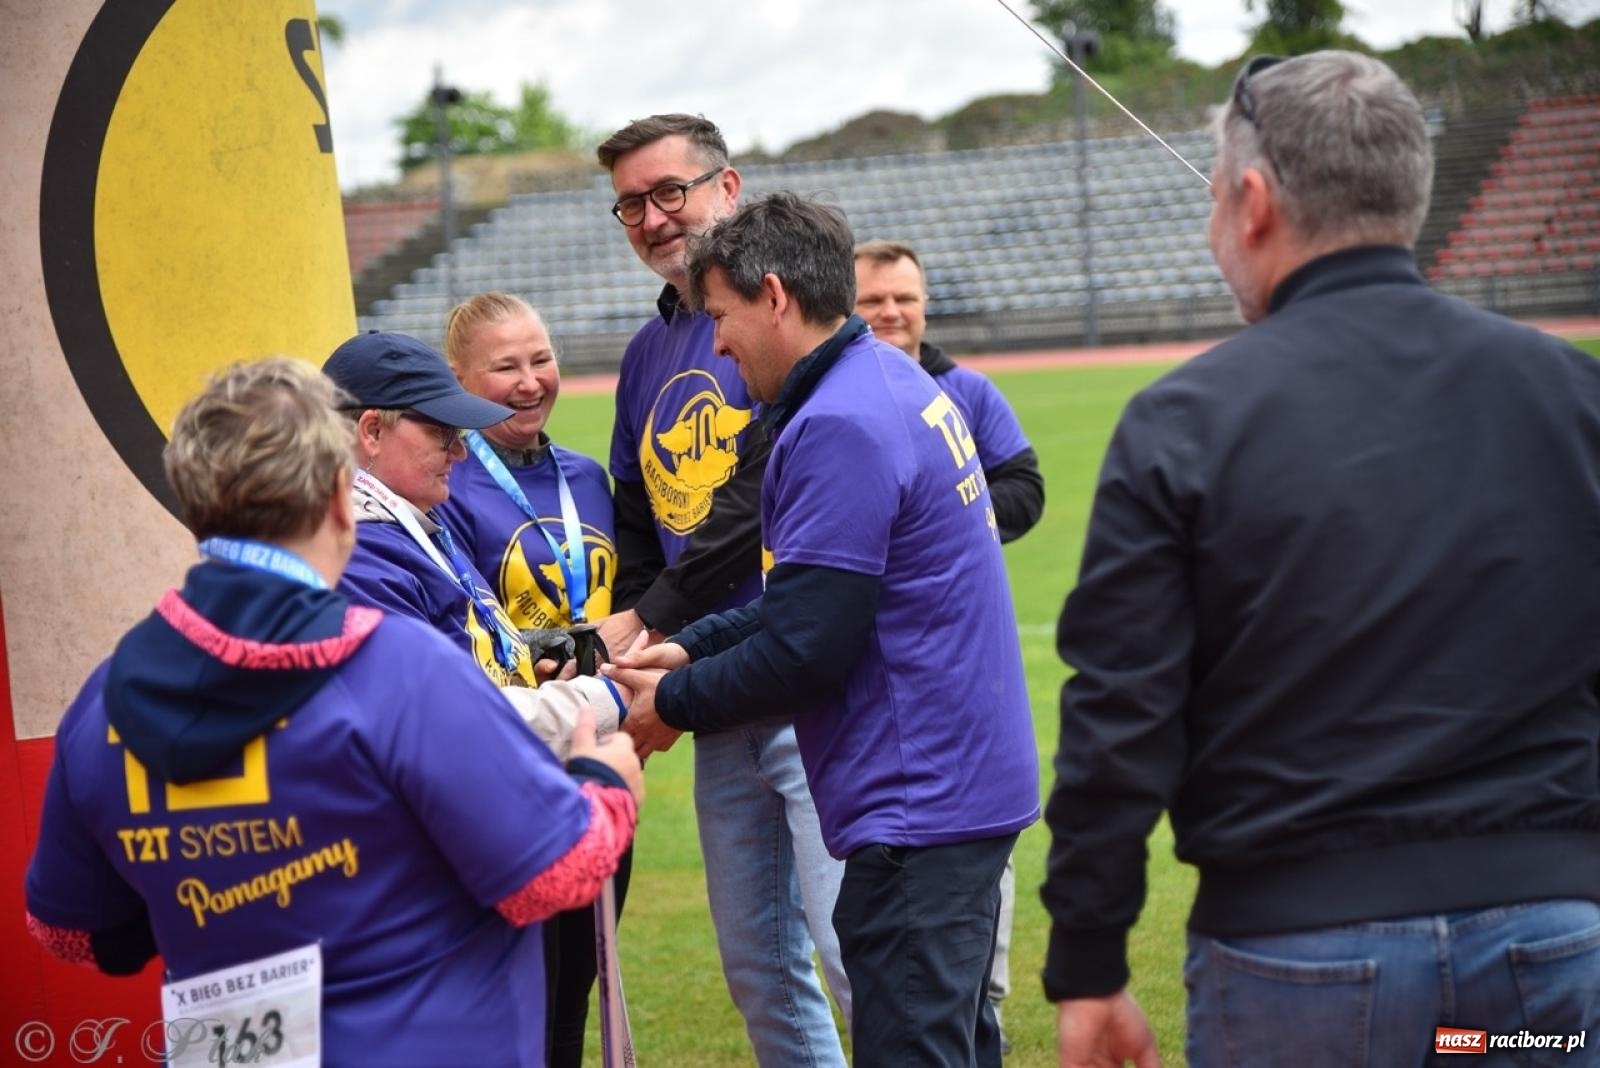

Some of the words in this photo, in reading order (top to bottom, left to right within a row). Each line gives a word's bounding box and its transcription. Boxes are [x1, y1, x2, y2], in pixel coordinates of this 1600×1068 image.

[645, 459, 689, 509] RACIBORSKI
[116, 826, 170, 862] T2T
[179, 816, 304, 859] SYSTEM
[176, 837, 360, 928] Pomagamy
[189, 981, 222, 1003] BIEG
[225, 973, 256, 993] BEZ
[211, 1010, 284, 1068] 163
